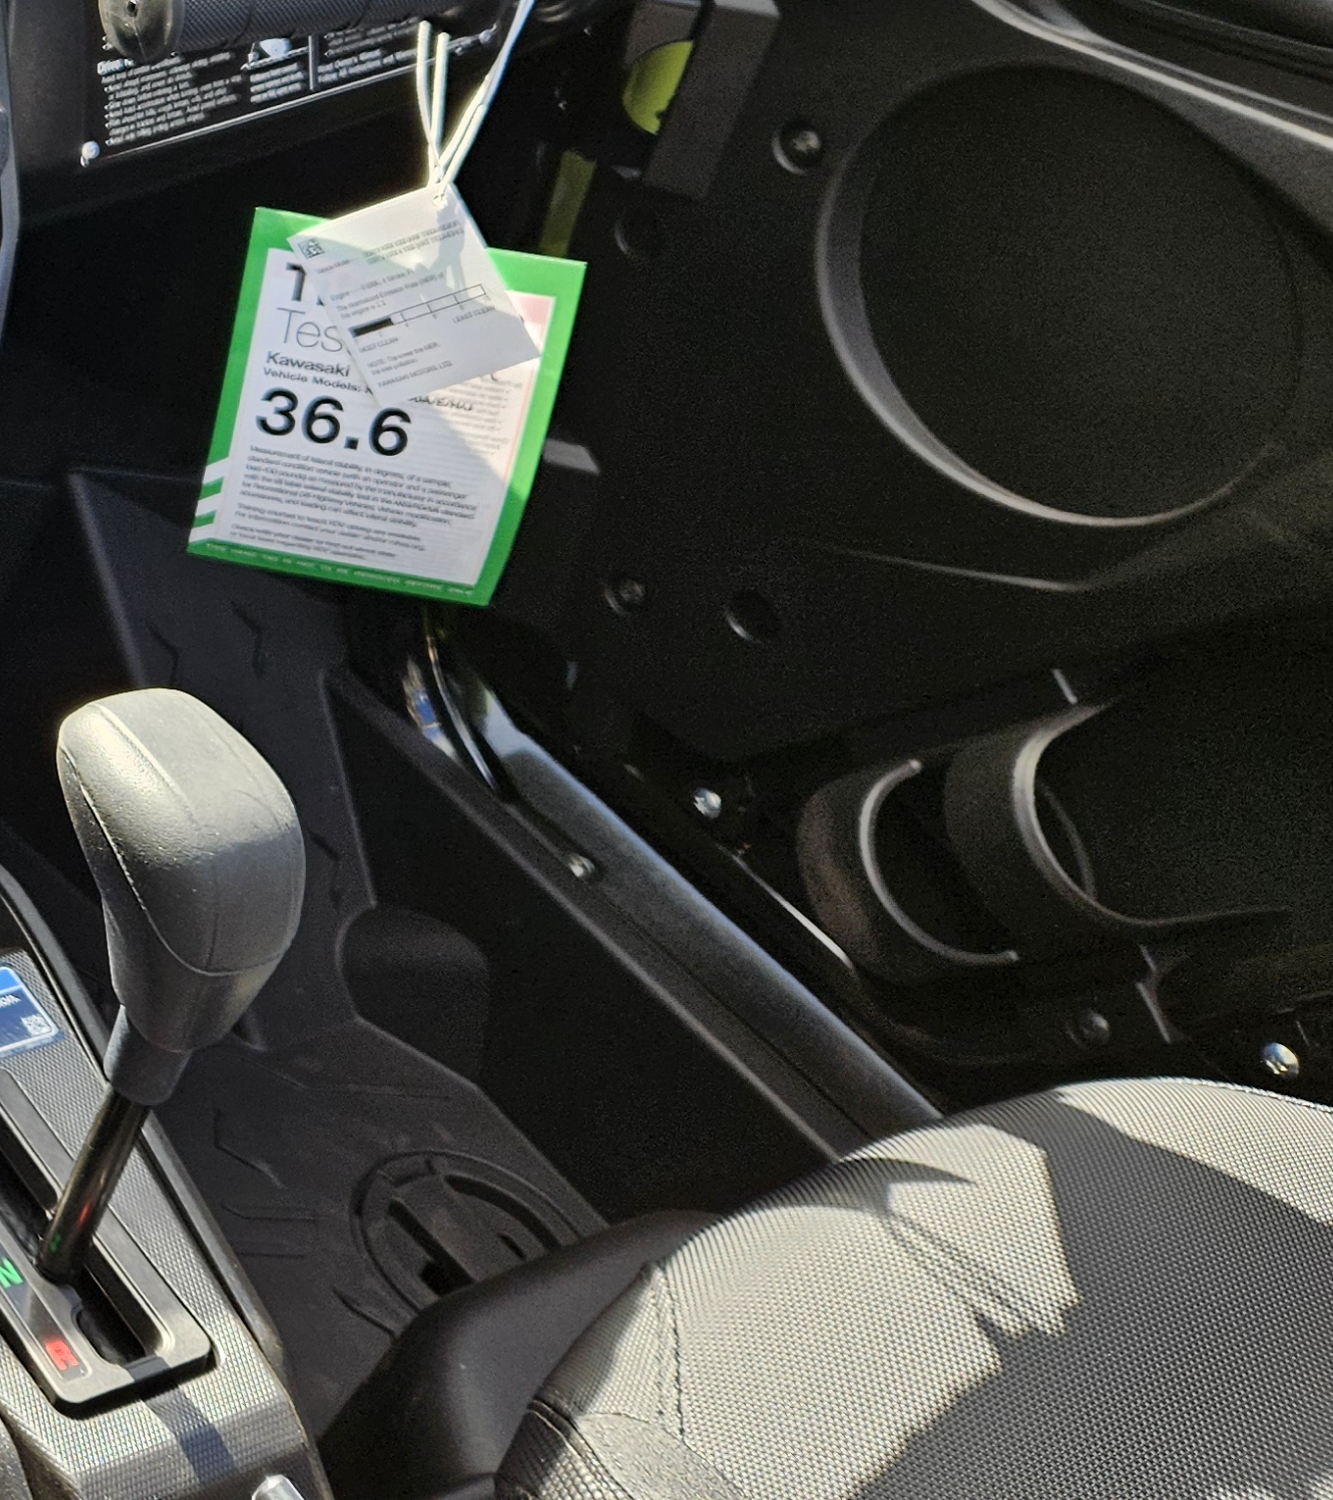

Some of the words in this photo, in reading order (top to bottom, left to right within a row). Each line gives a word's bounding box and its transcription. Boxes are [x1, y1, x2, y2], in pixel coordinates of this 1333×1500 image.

[277, 307, 352, 356] Tes
[263, 367, 308, 384] Vehicle
[312, 375, 362, 393] Models:
[266, 351, 351, 378] Kawasaki
[256, 387, 412, 456] 36.6
[43, 1337, 79, 1372] R
